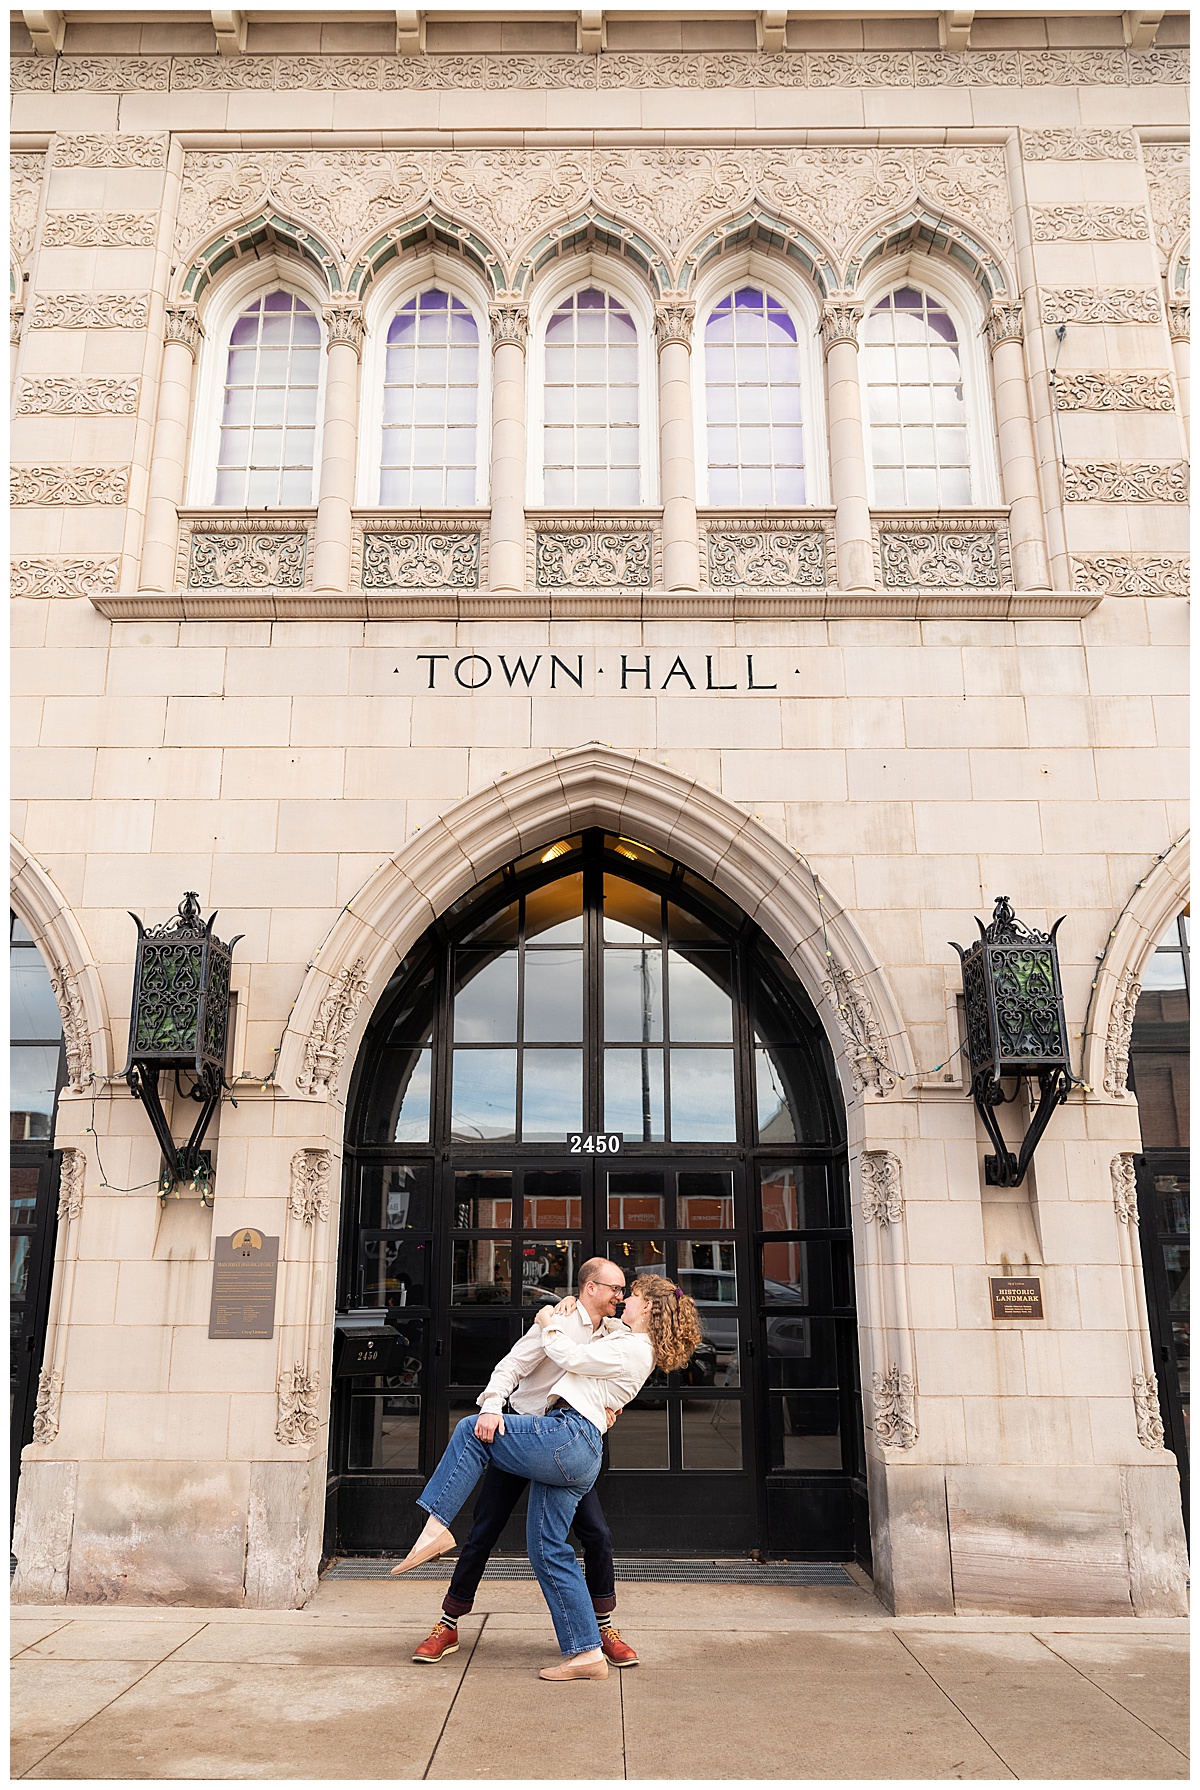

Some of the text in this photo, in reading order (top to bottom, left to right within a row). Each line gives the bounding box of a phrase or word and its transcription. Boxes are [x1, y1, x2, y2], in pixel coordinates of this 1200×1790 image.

[416, 654, 778, 690] TOWN HALL
[570, 1135, 620, 1153] 2450
[357, 1351, 378, 1361] 2450
